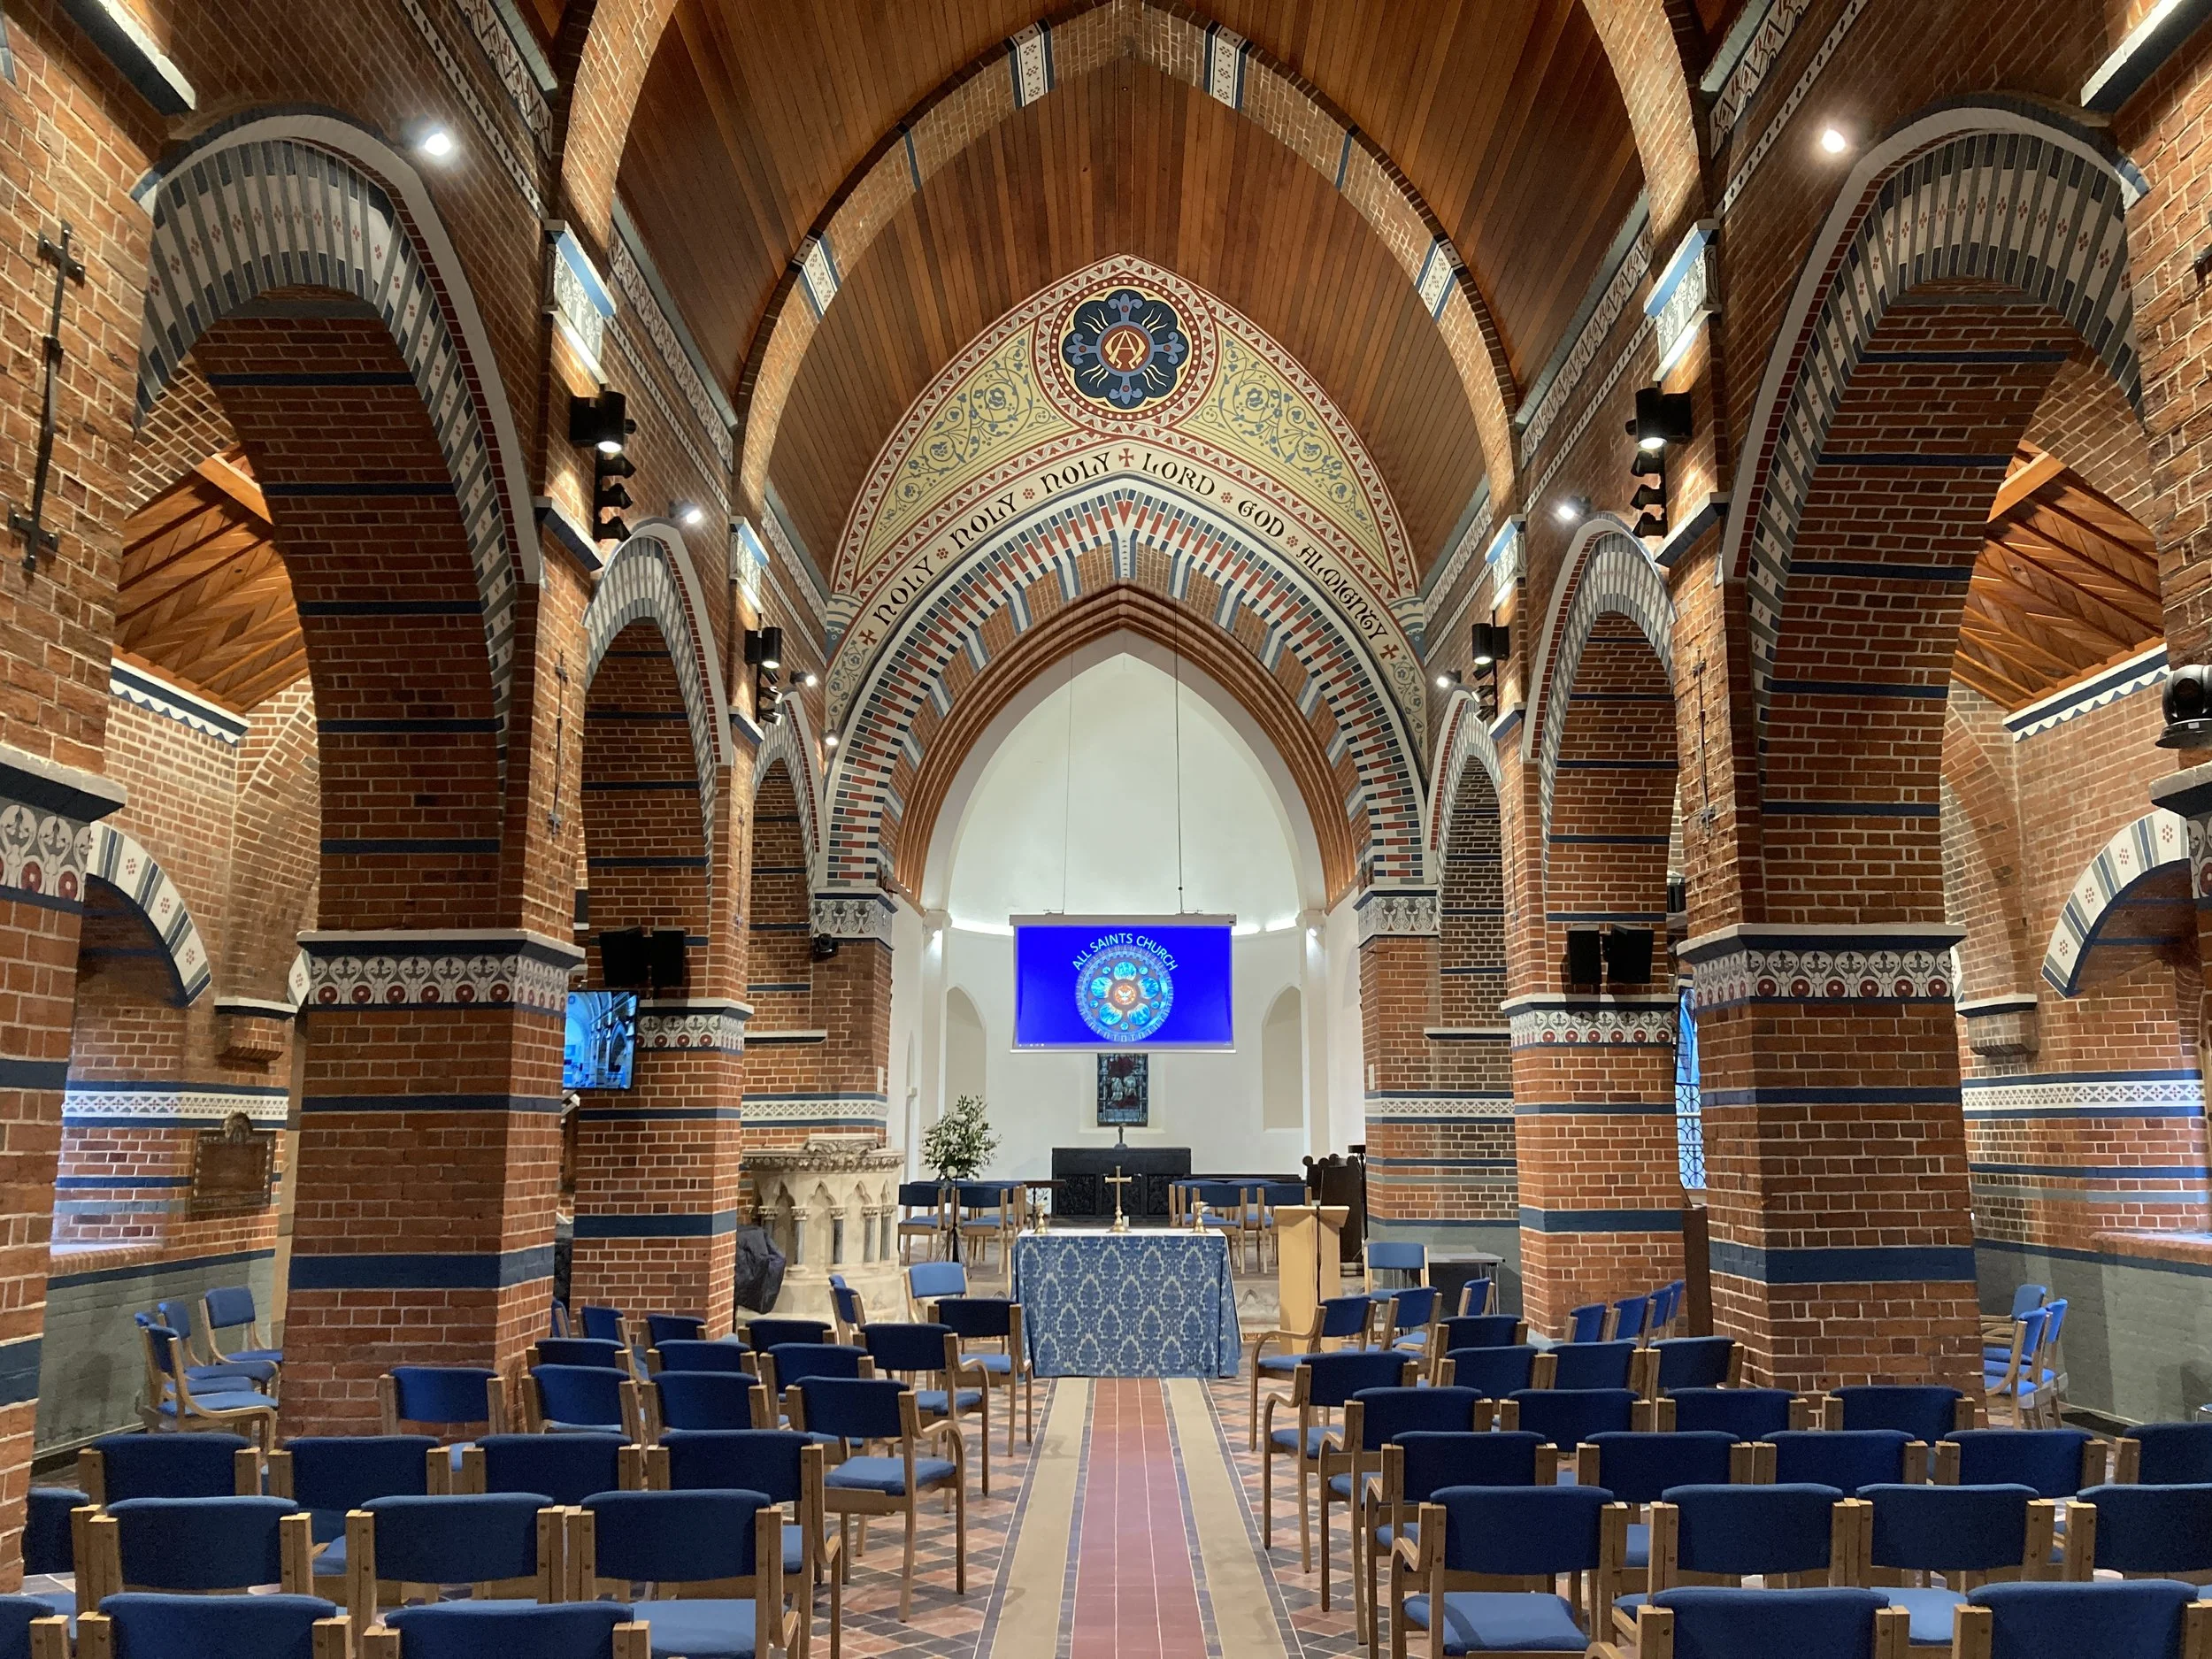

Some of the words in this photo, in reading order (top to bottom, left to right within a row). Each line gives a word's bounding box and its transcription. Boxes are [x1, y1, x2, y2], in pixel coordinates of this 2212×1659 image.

[872, 555, 935, 626] HOLY
[949, 491, 1017, 549] HOLY
[1040, 451, 1110, 494] HOLY
[1141, 452, 1216, 495] LORD
[1238, 500, 1285, 538] GOD
[1295, 542, 1389, 641] ALMIGHTY
[1072, 950, 1092, 971] ALL
[1089, 933, 1133, 953] SAINTS
[1136, 935, 1179, 971] CHURCH
